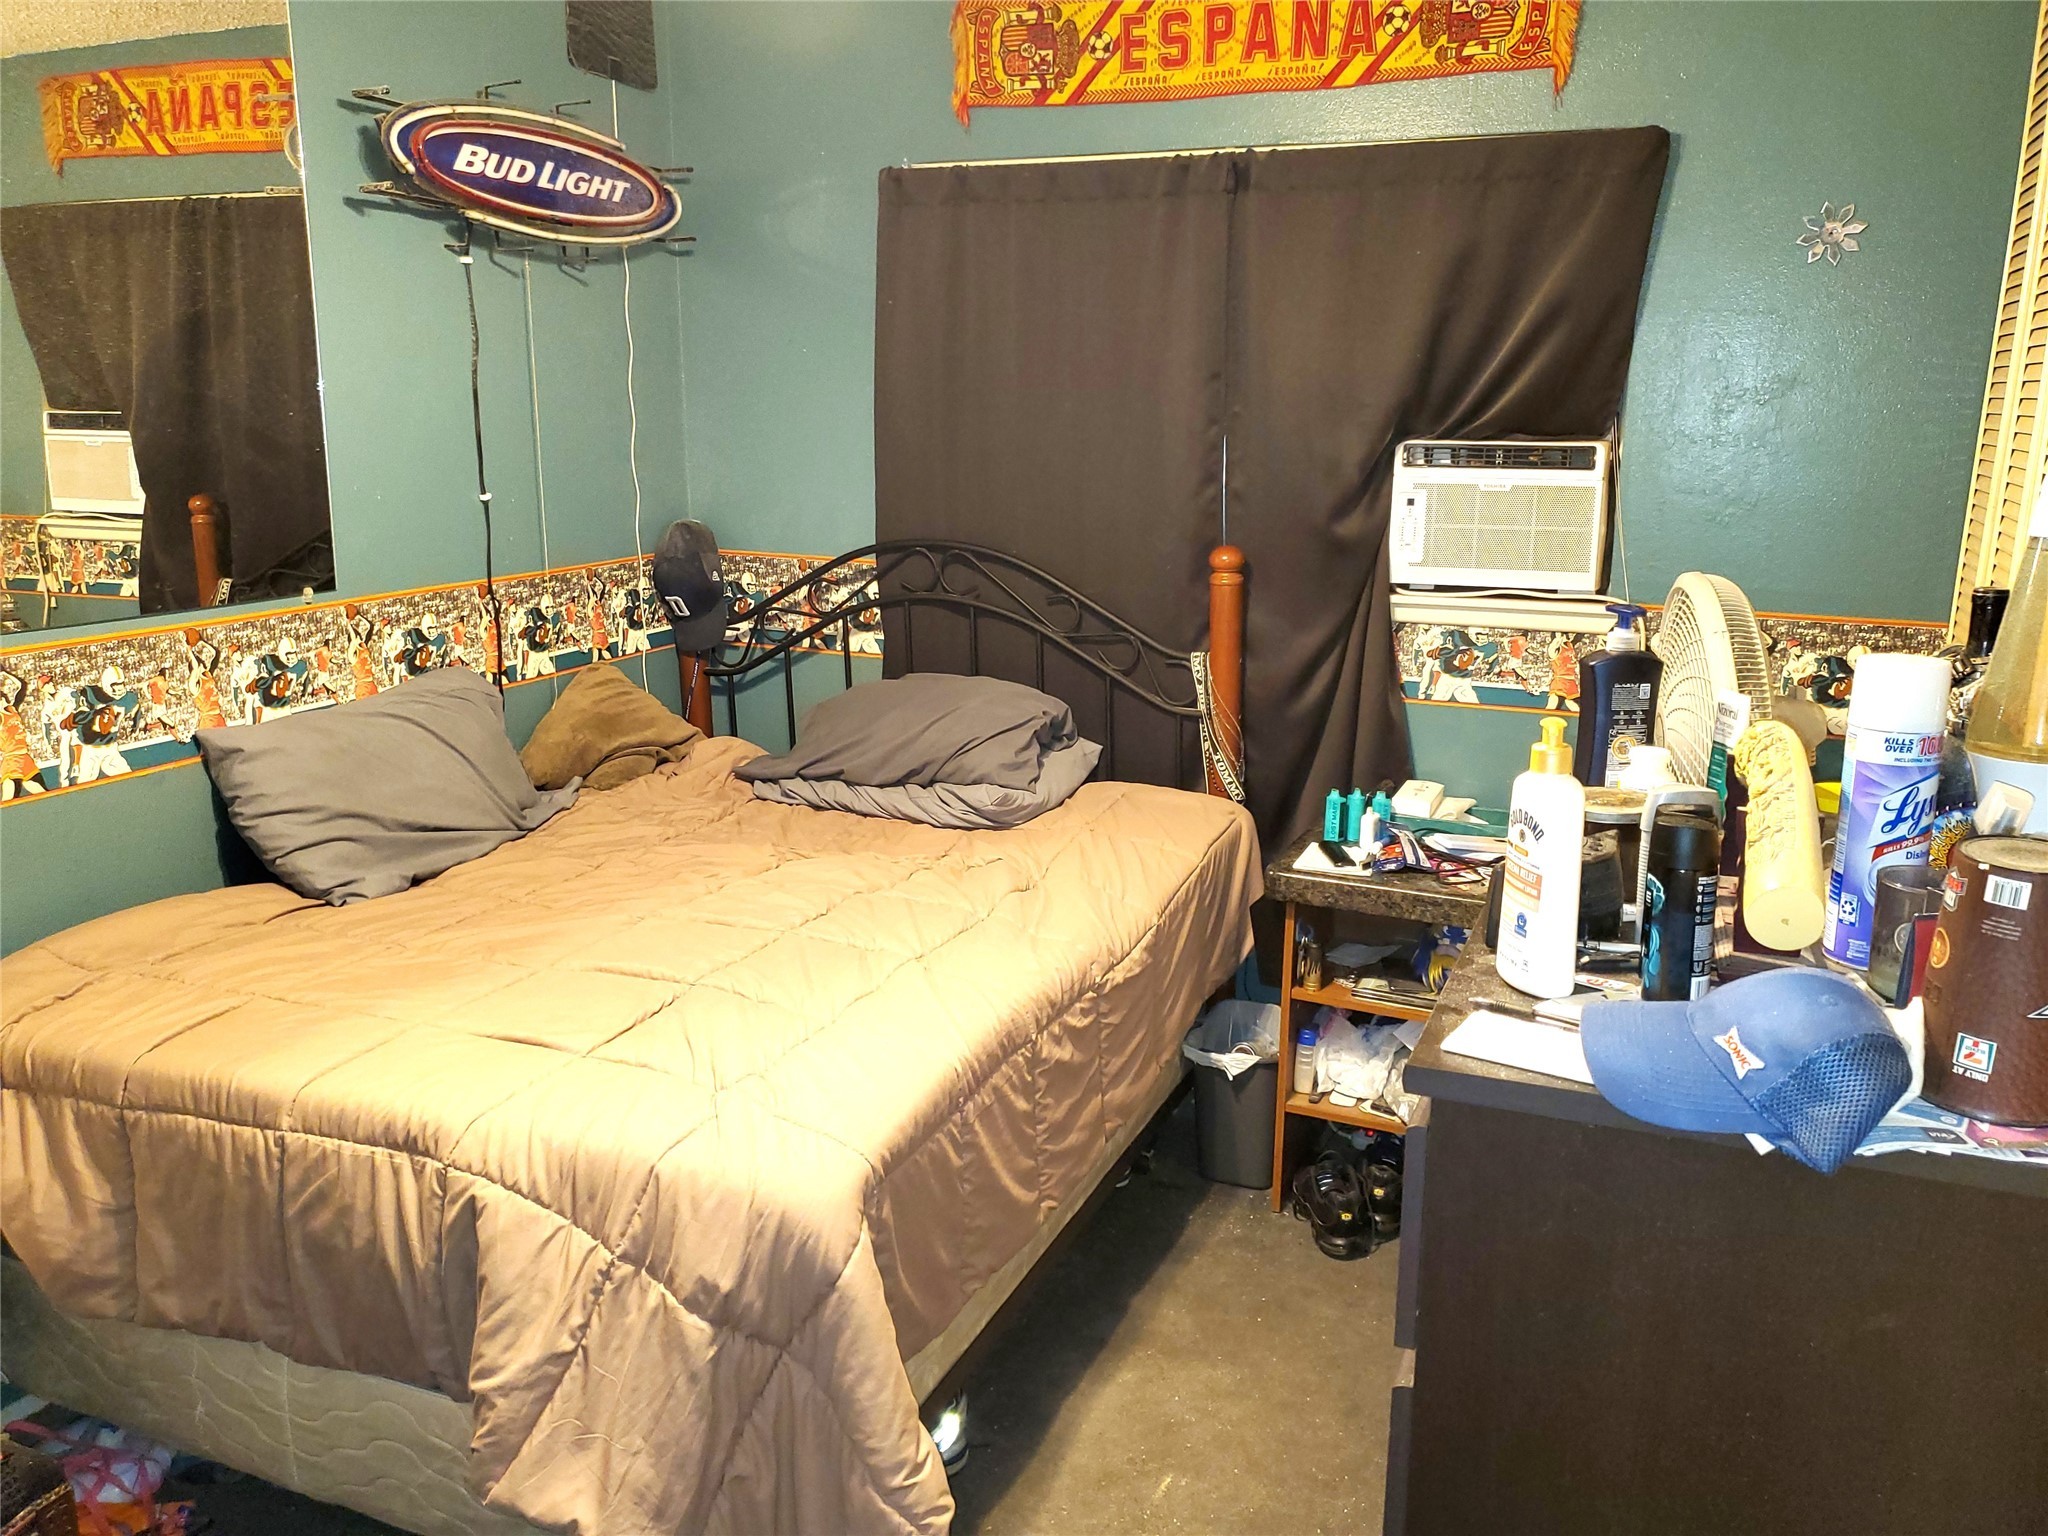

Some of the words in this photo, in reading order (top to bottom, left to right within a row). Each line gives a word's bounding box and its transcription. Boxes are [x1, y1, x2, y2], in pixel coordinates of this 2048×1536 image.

[1884, 737, 1914, 746] KILLS
[1885, 745, 1913, 753] OVER
[1881, 786, 1936, 835] Lys
[1330, 821, 1338, 839] LOST
[1523, 811, 1545, 841] BOND
[1723, 1035, 1751, 1069] SONIC
[1952, 1065, 1966, 1075] AT
[1965, 1070, 1989, 1083] ONLY
